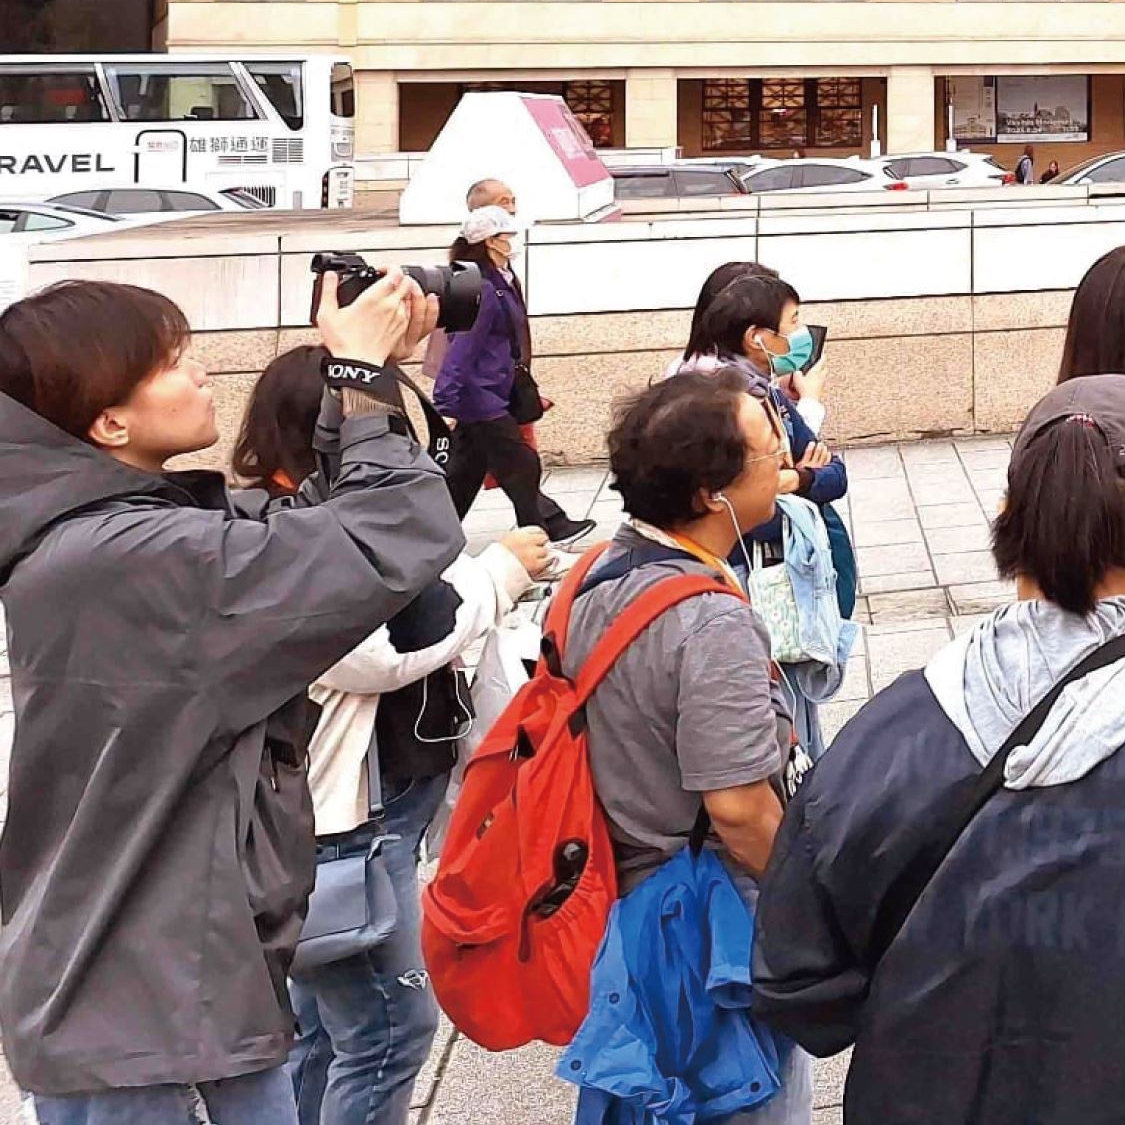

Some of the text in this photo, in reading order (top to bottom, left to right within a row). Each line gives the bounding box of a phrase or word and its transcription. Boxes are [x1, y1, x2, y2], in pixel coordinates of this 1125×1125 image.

[188, 136, 269, 153] 雄獅通運
[328, 364, 381, 383] ONY
